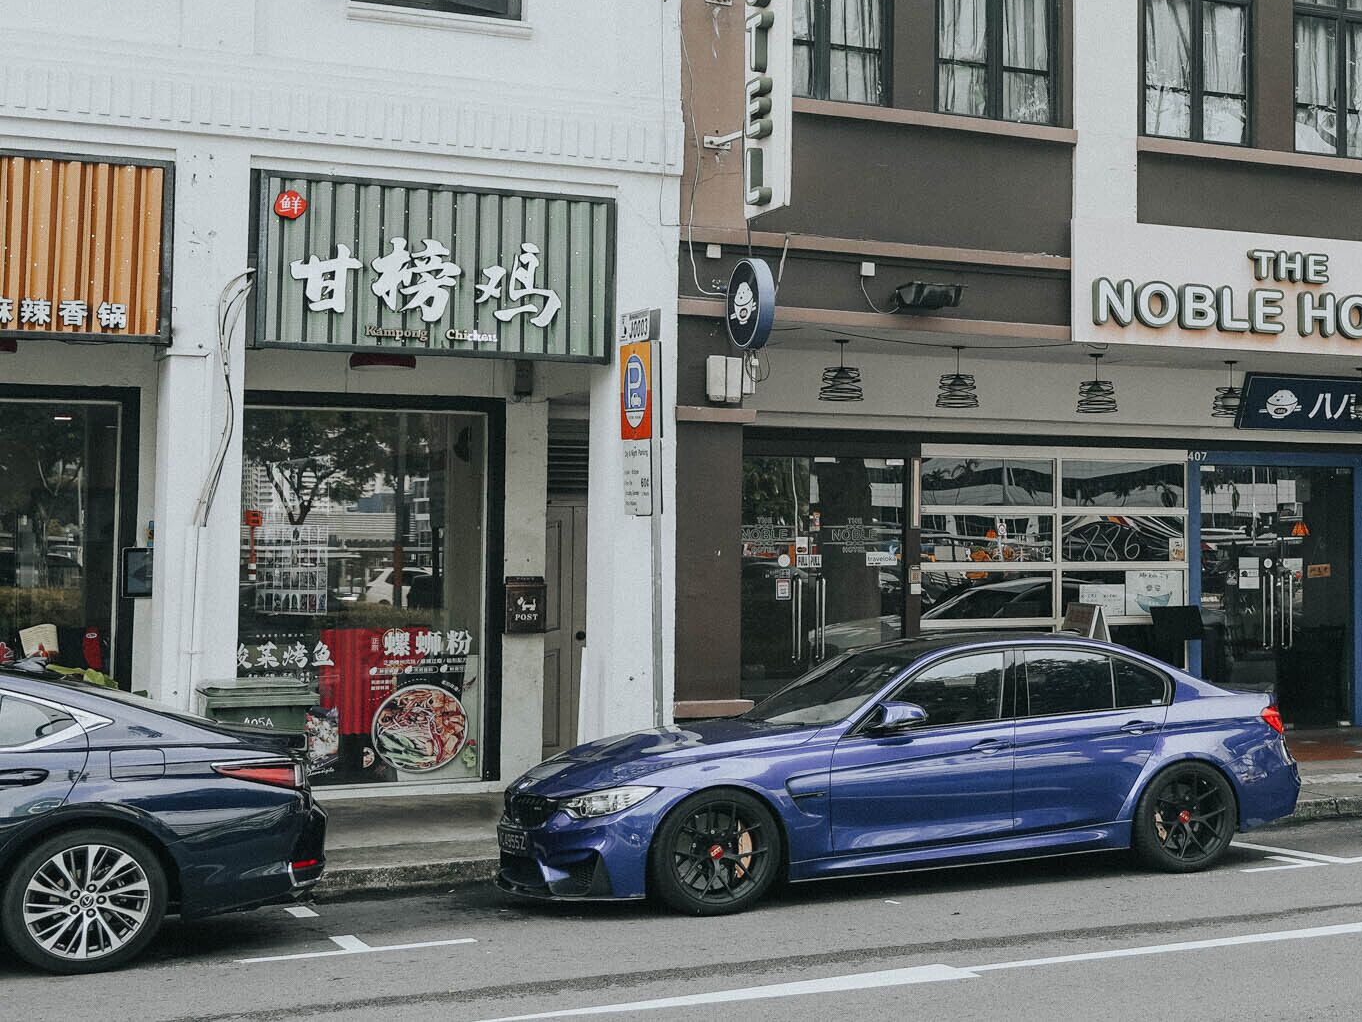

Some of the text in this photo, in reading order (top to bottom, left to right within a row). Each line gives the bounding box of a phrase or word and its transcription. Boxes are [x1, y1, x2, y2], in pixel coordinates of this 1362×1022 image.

[280, 190, 302, 213] 鲜
[1247, 249, 1330, 284] THE
[290, 236, 562, 328] 甘榜鸡
[1092, 277, 1286, 335] NOBLE
[364, 325, 498, 343] Kampong Chicken
[1188, 451, 1208, 462] 407
[741, 528, 788, 539] NOBLE
[831, 529, 878, 541] NOBLE
[842, 546, 866, 554] HOTEL
[515, 613, 538, 621] POST
[383, 629, 473, 657] 螺蛳粉
